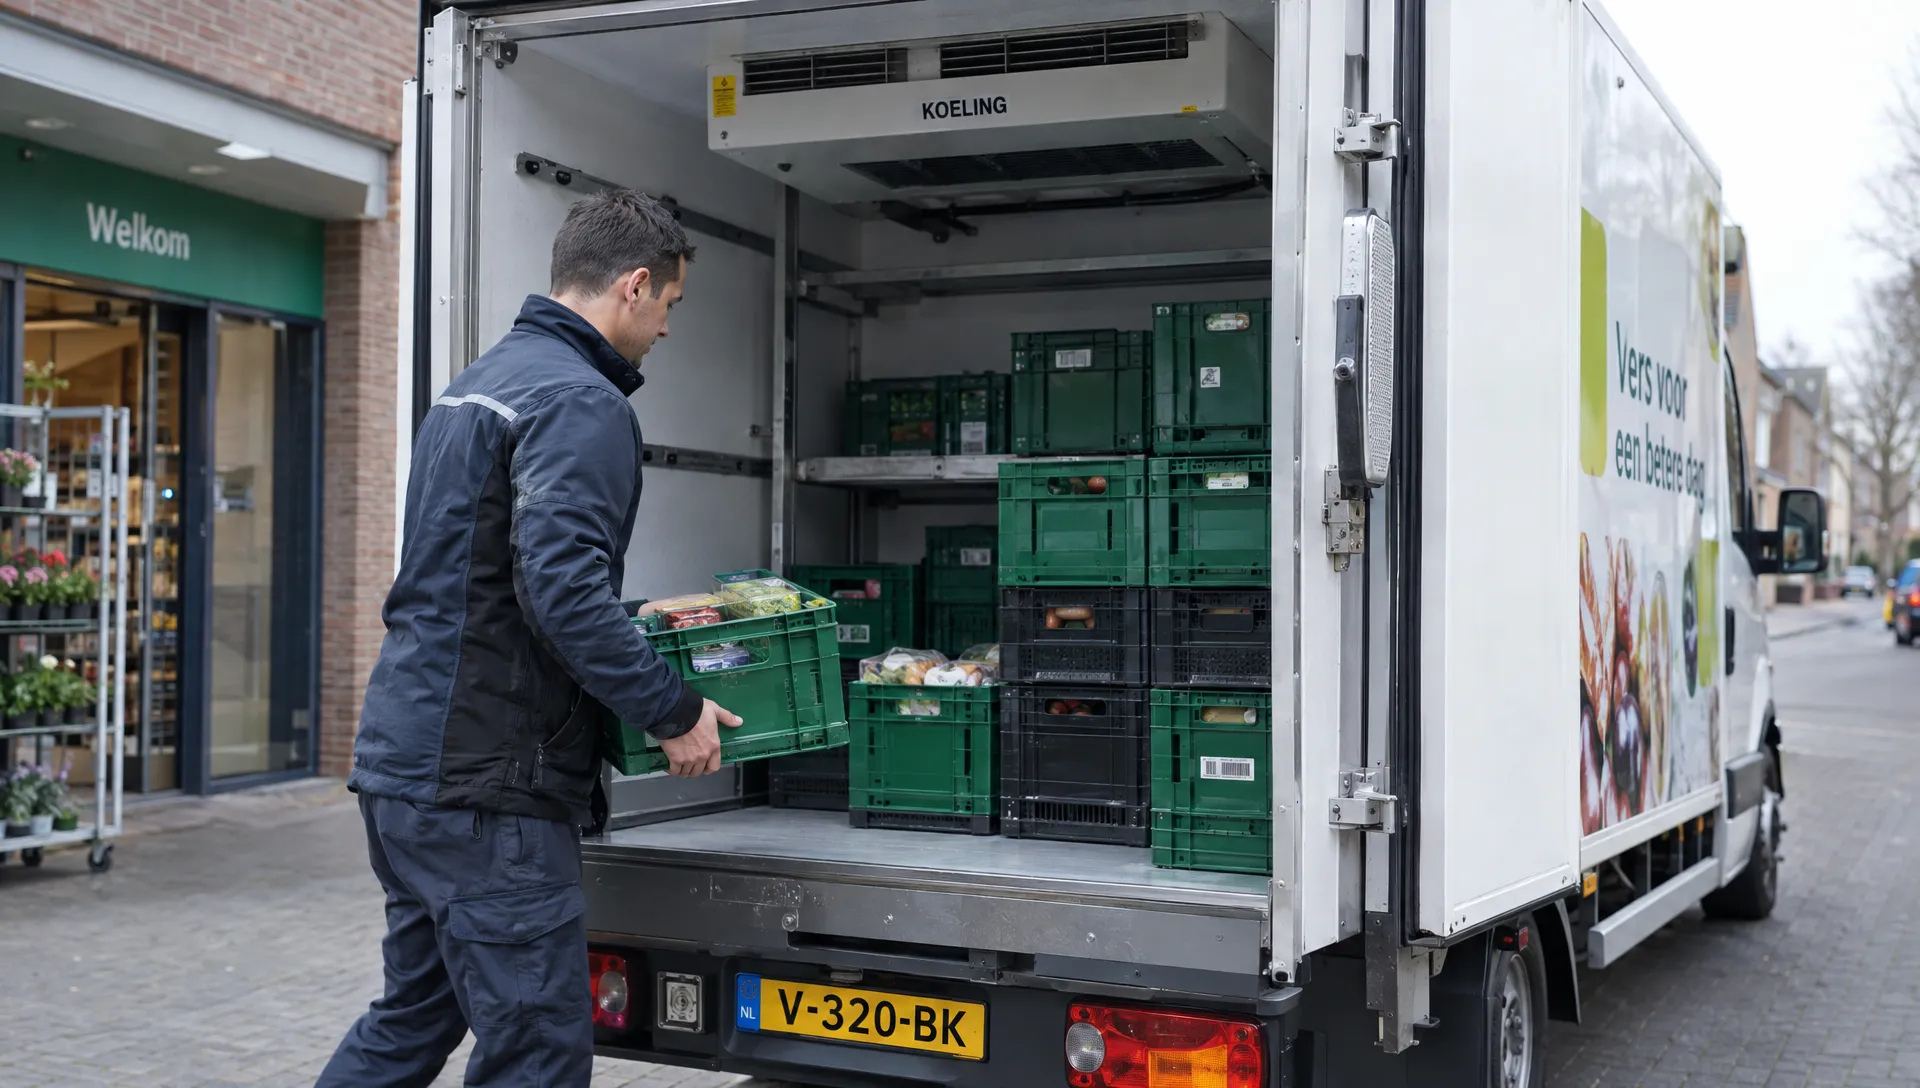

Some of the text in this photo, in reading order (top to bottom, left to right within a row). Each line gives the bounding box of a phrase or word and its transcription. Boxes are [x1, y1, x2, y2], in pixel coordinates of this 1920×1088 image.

[922, 96, 1007, 120] KOELING
[87, 202, 190, 261] Welkom
[1616, 320, 1688, 422] Vers voor
[1615, 422, 1705, 515] een betere dag
[740, 1006, 756, 1020] NL
[778, 987, 967, 1048] V-320-BK
